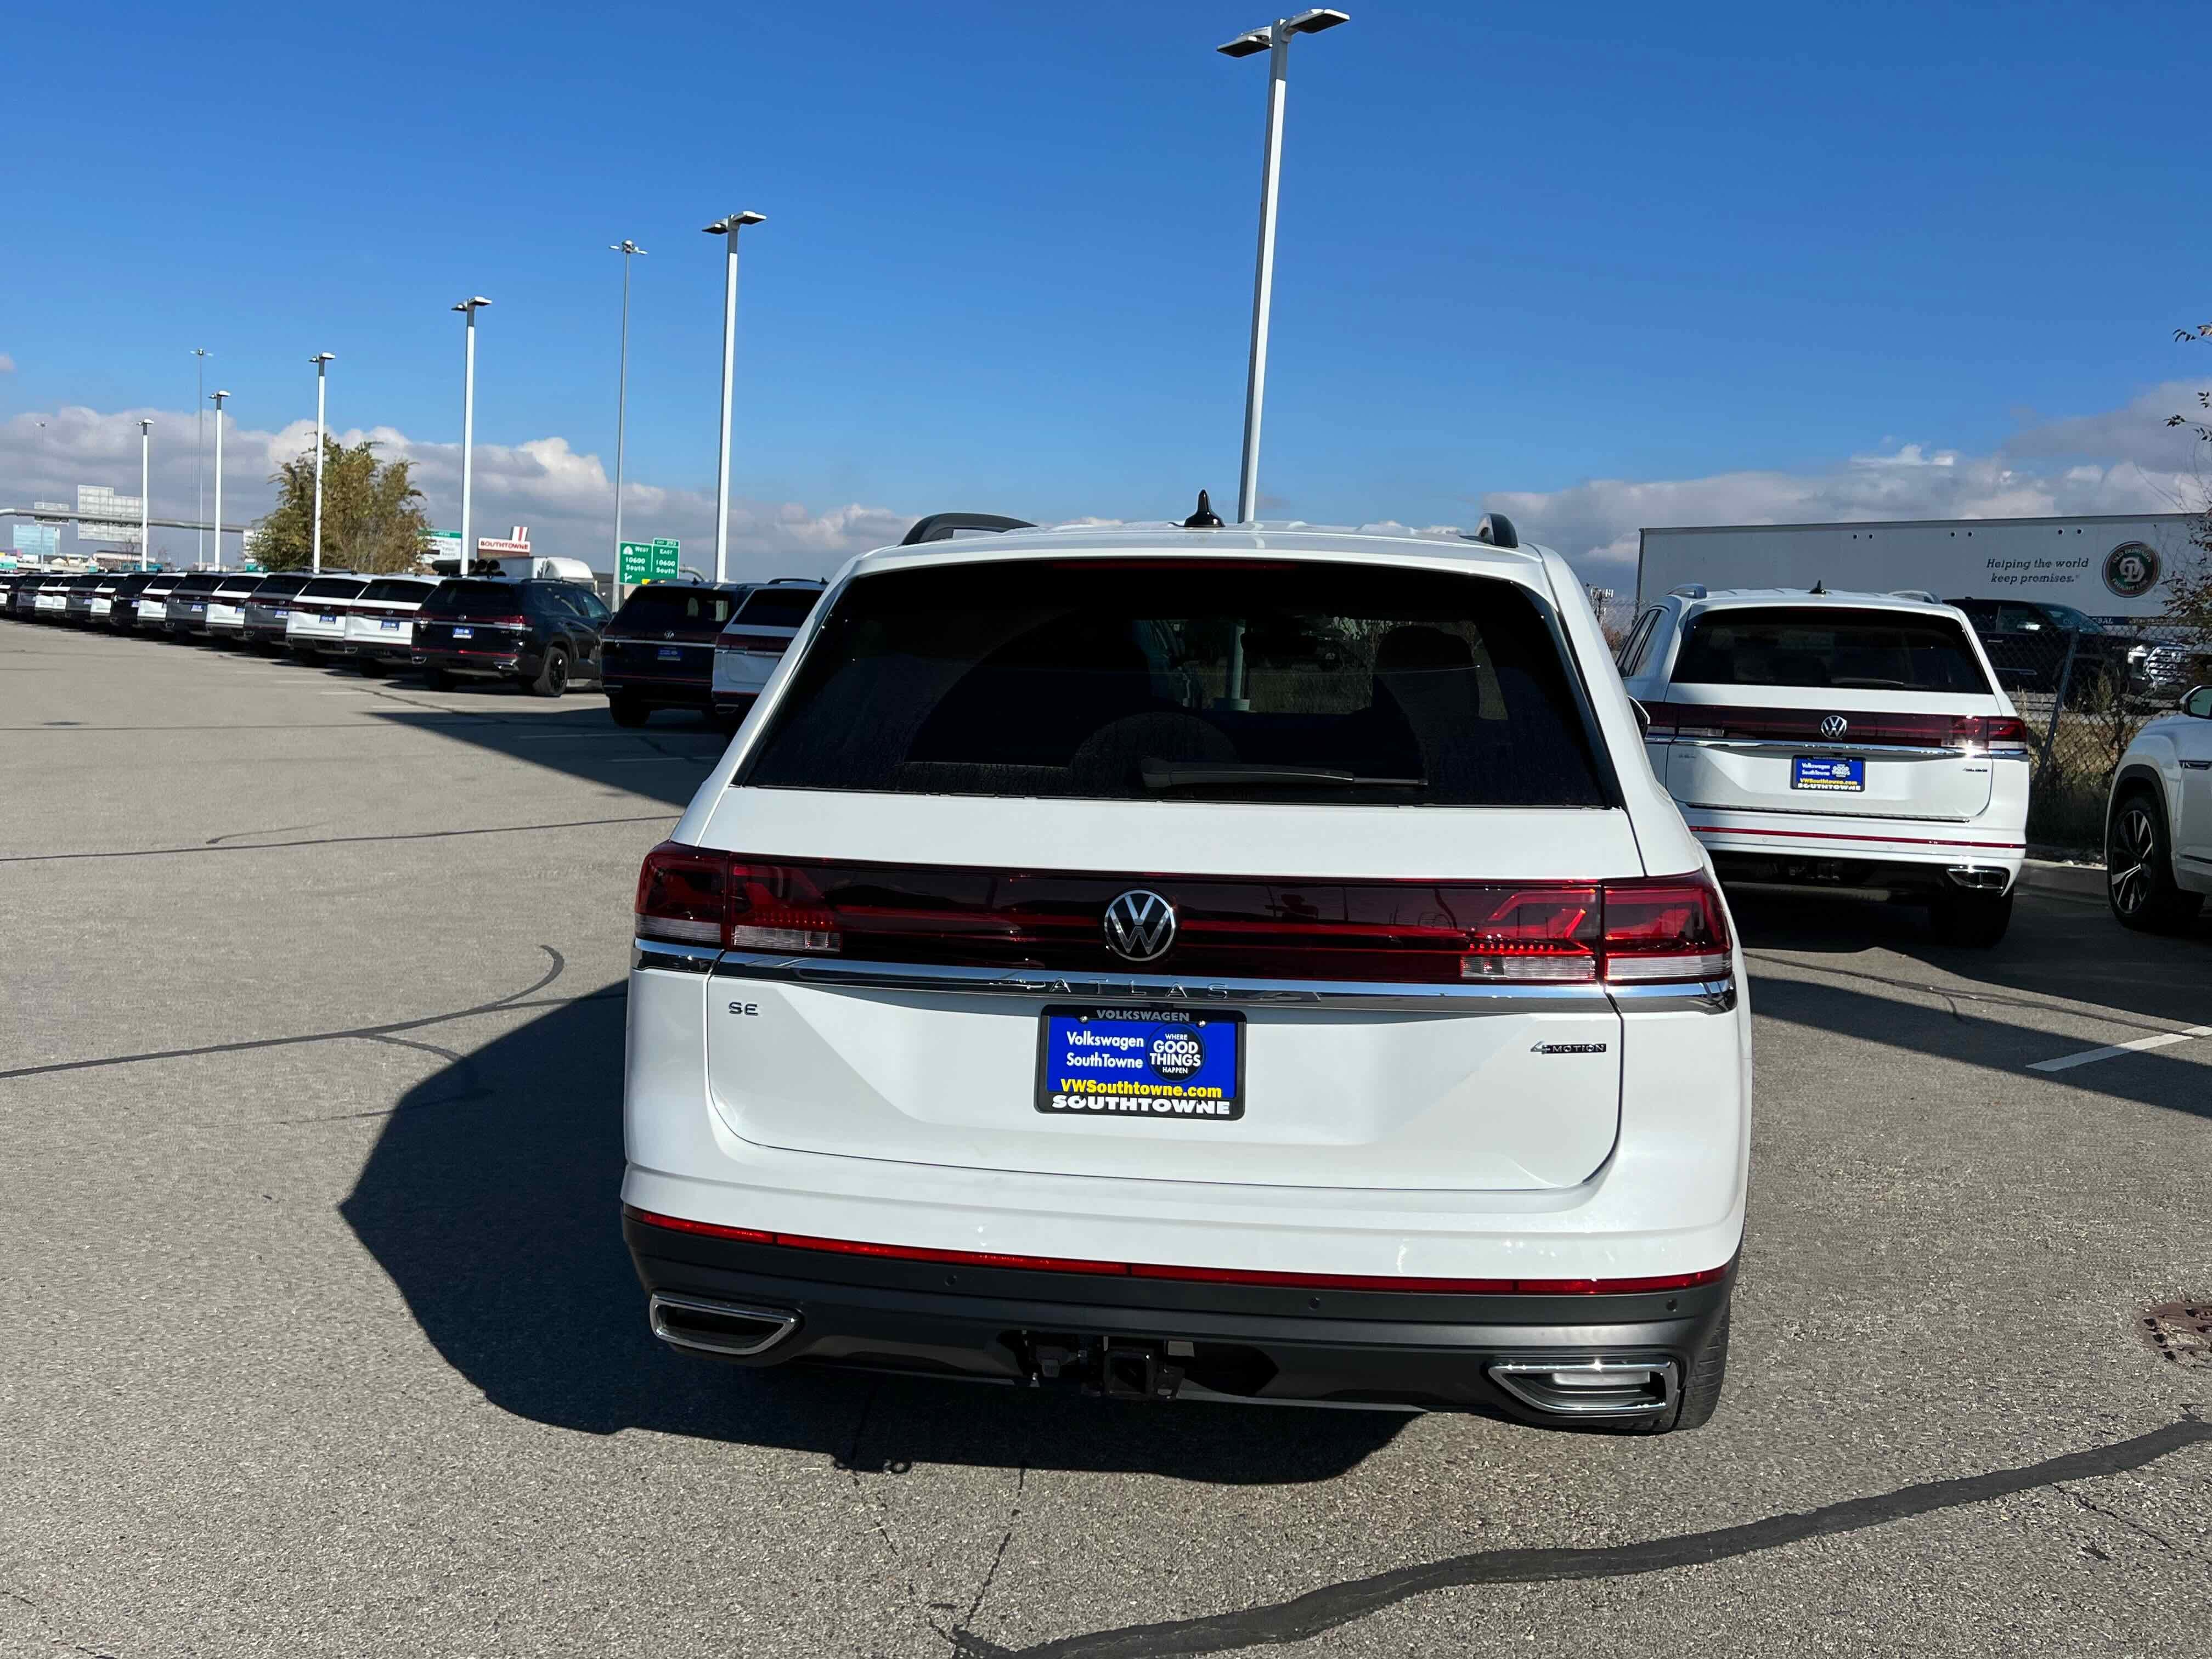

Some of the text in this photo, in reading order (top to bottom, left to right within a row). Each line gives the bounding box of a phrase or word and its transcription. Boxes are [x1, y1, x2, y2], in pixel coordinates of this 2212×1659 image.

[480, 540, 529, 550] SOUTHTOWNE
[1987, 558, 2089, 570] Helping the world
[1991, 573, 2075, 585] keep promises.
[1048, 977, 1228, 1000] ATLAS
[729, 1001, 759, 1016] SE
[1097, 1009, 1190, 1022] VOLKSWAGEN
[1066, 1031, 1144, 1051] Volkswagen
[1153, 1040, 1198, 1054] GOOD
[1530, 1041, 1606, 1054] 4MOTION
[1149, 1052, 1201, 1067] THINGS
[1060, 1078, 1222, 1098] VWSouthtowne.com
[1051, 1094, 1230, 1115] SOUTHTOWNE
